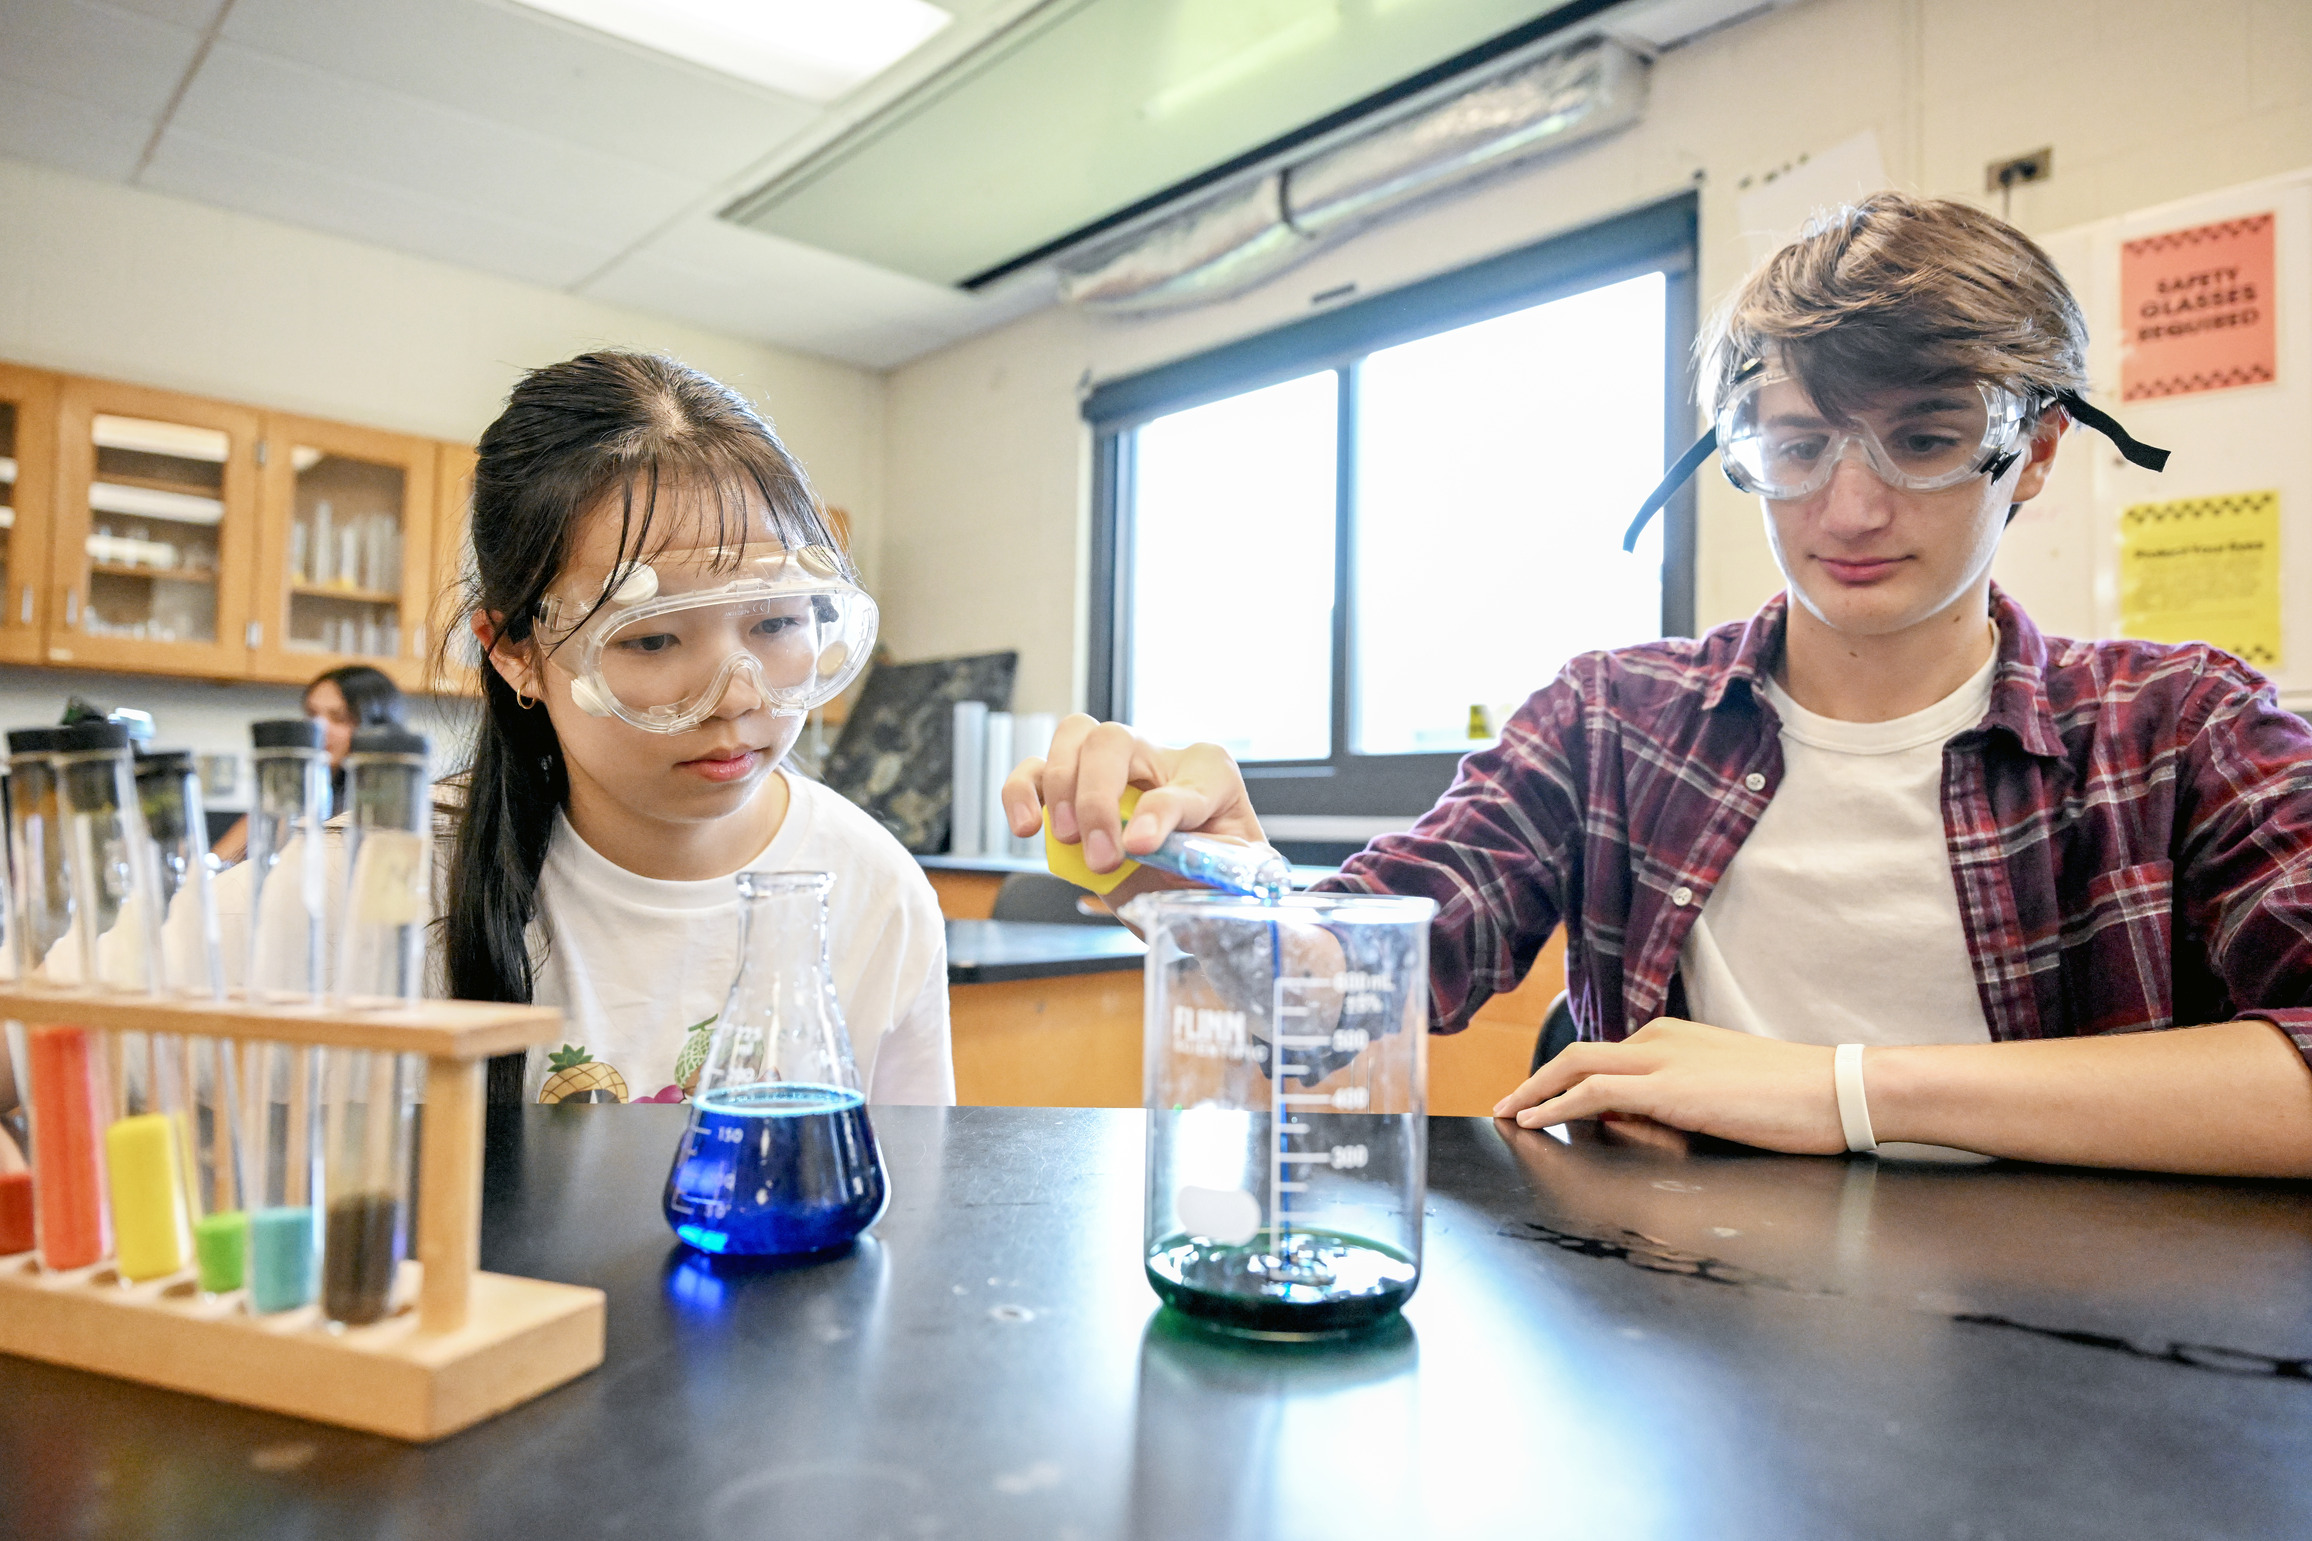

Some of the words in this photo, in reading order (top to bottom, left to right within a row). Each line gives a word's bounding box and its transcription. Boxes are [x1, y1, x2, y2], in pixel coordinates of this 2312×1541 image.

[2158, 268, 2238, 294] SAFETY
[2140, 283, 2256, 319] GLASSES
[718, 1126, 744, 1144] 150
[1331, 1144, 1368, 1169] 300
